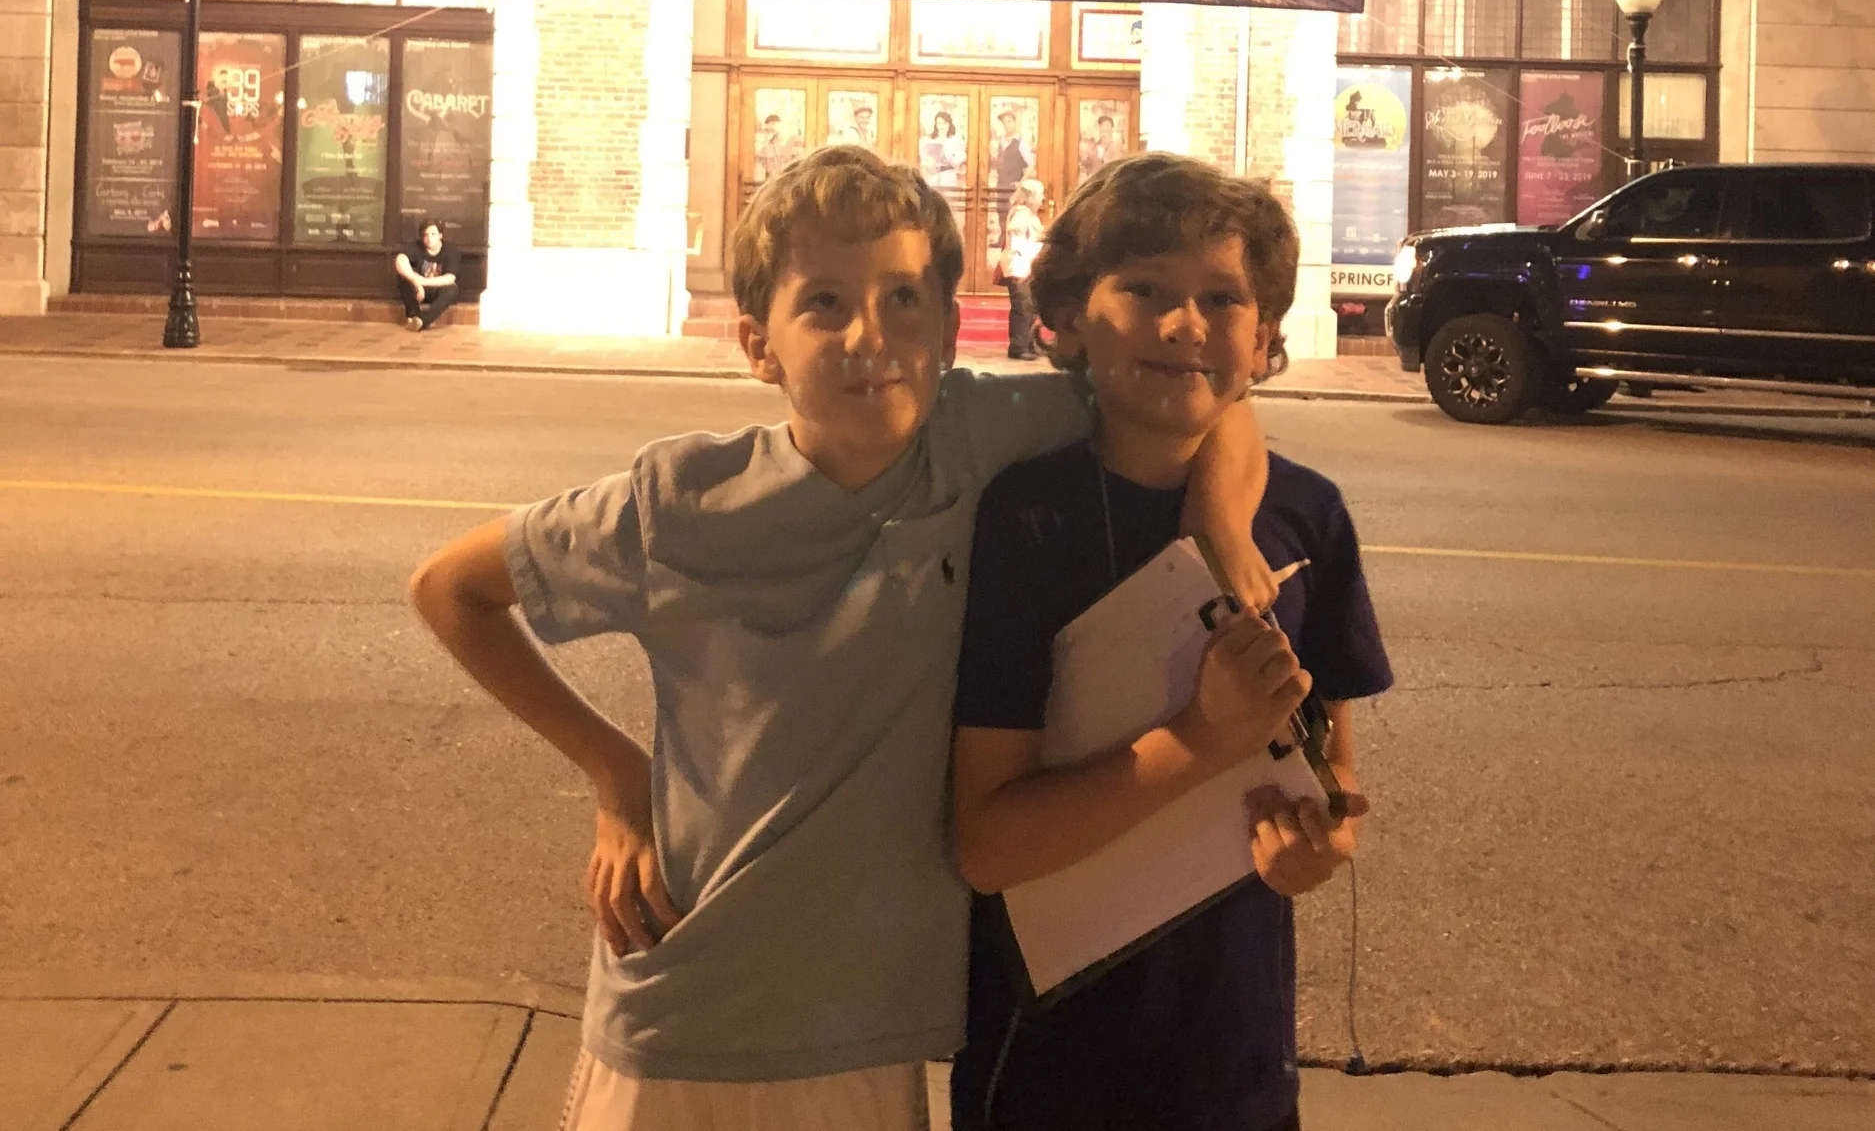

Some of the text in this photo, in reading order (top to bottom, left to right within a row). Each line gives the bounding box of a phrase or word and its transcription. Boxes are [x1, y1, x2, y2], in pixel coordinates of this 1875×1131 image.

[226, 68, 261, 103] 39
[226, 101, 260, 118] SPS
[1428, 169, 1449, 178] MAY
[1450, 170, 1457, 178] 3
[1478, 170, 1498, 179] 2019
